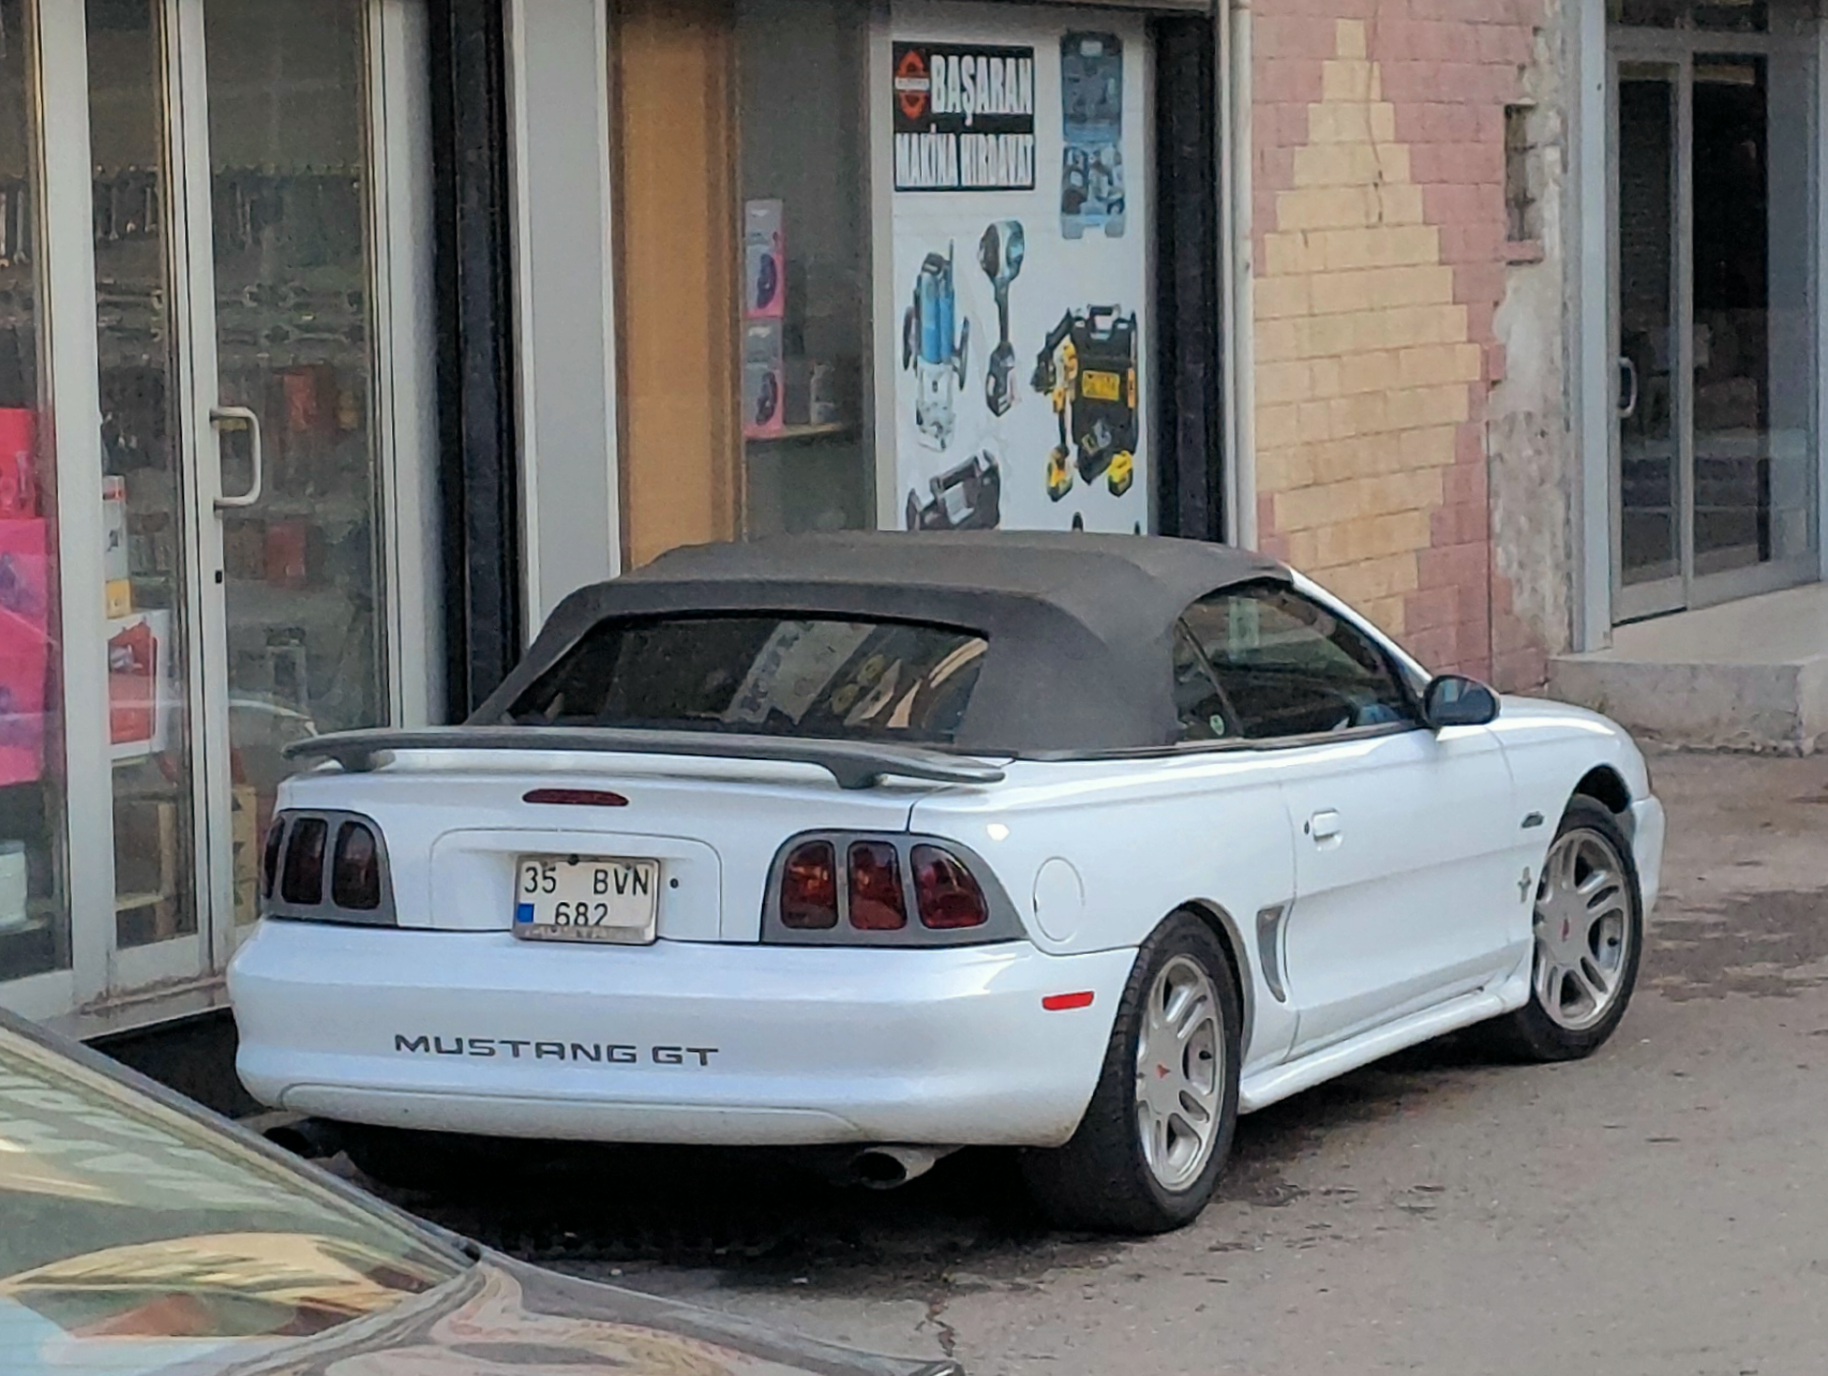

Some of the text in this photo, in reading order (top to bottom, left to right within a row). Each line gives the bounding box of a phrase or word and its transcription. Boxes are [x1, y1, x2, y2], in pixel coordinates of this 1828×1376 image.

[930, 54, 1032, 126] BAŞARAN
[895, 123, 1034, 186] MAKİNA HIRDAVAT
[524, 866, 649, 895] 35 BVN
[555, 902, 608, 926] 682
[394, 1034, 719, 1066] MUSTANG GT
